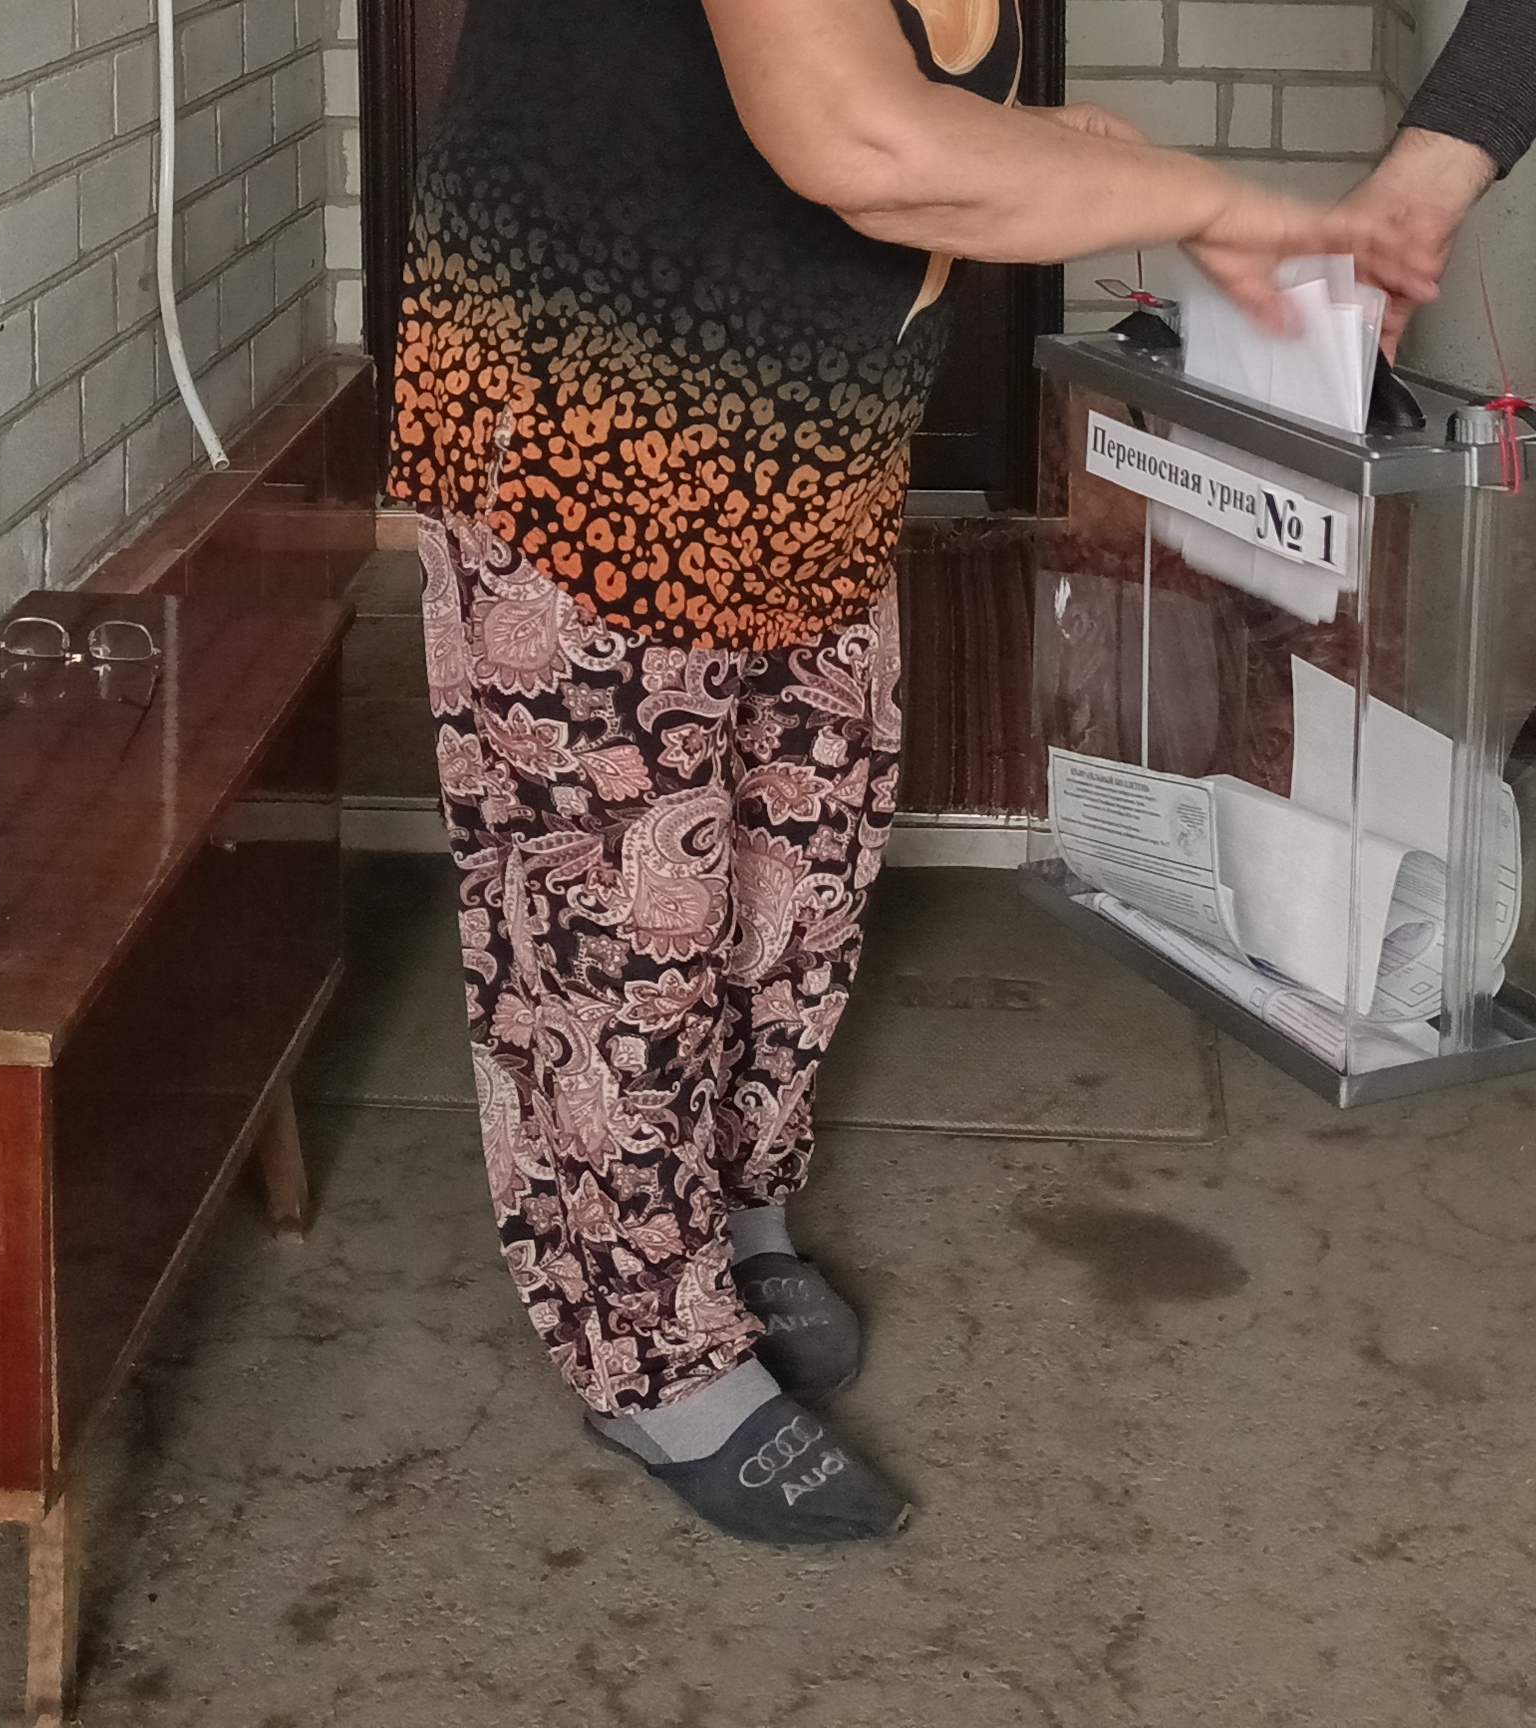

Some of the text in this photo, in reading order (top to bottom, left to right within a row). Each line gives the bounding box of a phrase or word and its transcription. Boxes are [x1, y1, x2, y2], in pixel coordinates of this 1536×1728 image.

[1092, 424, 1203, 495] Переносная
[1207, 477, 1257, 513] урна
[1319, 514, 1337, 566] 1
